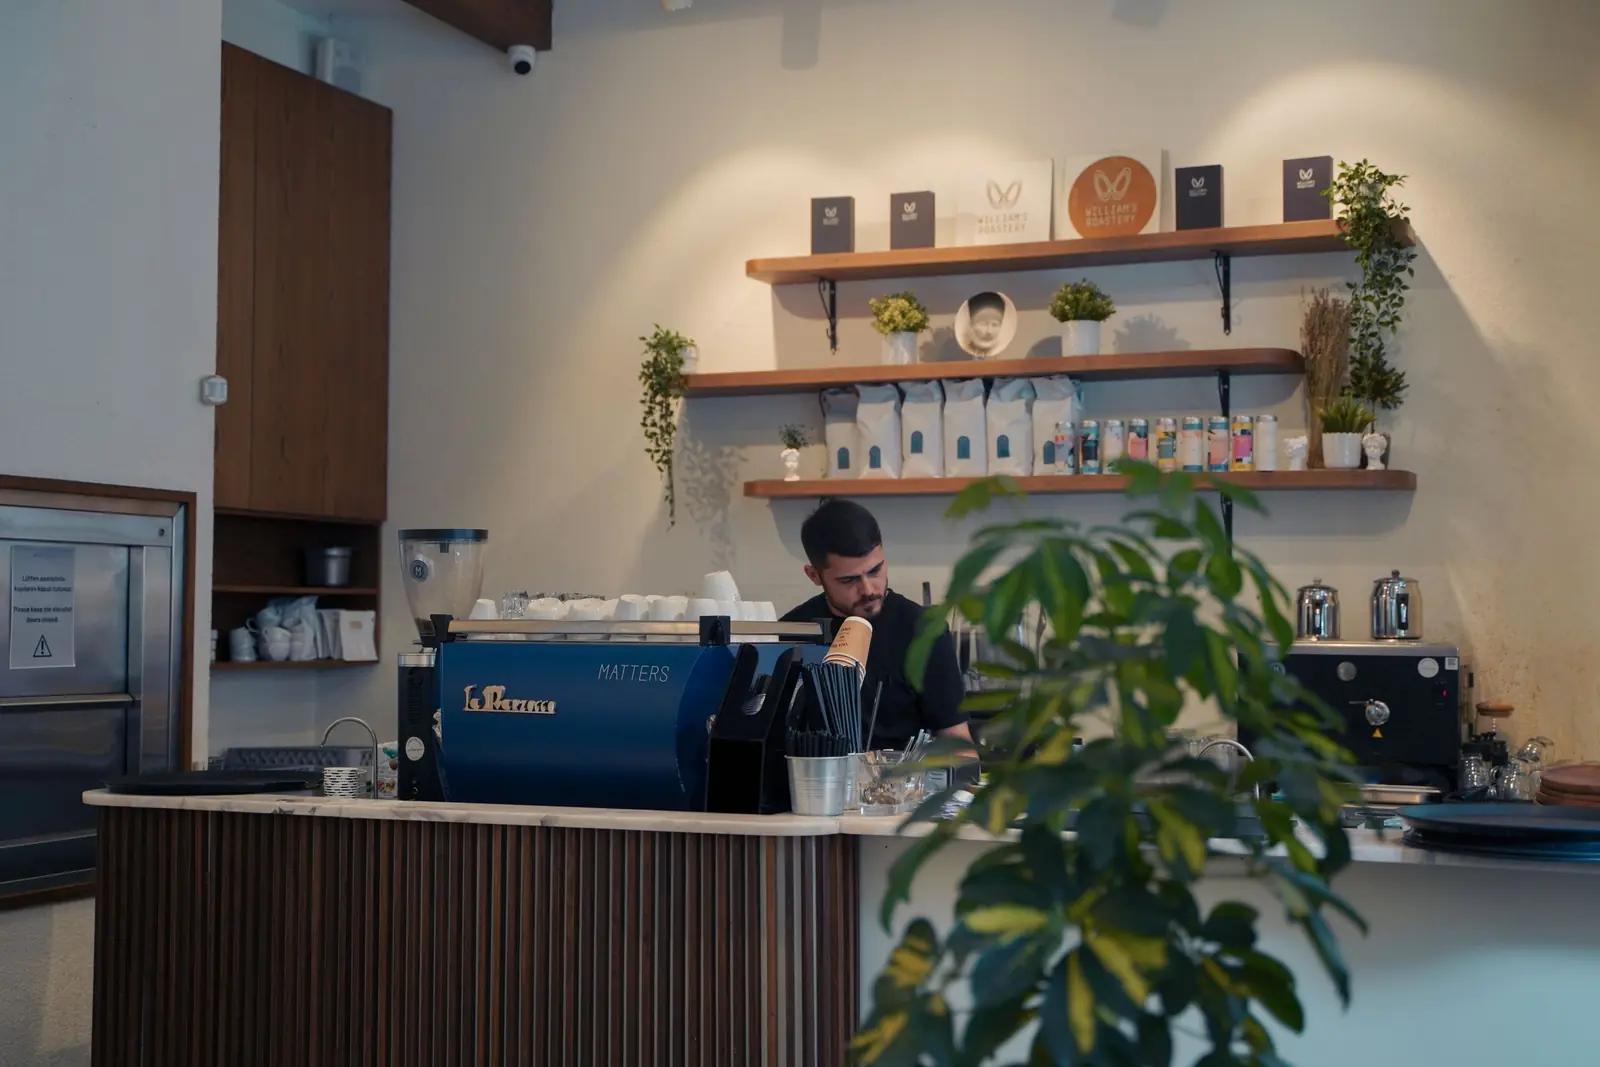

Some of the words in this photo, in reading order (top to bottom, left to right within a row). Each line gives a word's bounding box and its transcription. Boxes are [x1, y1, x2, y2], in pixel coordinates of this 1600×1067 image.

[1085, 204, 1137, 217] WILLIAM'S
[1085, 215, 1136, 227] ROASTERY
[597, 664, 670, 683] MATTERS
